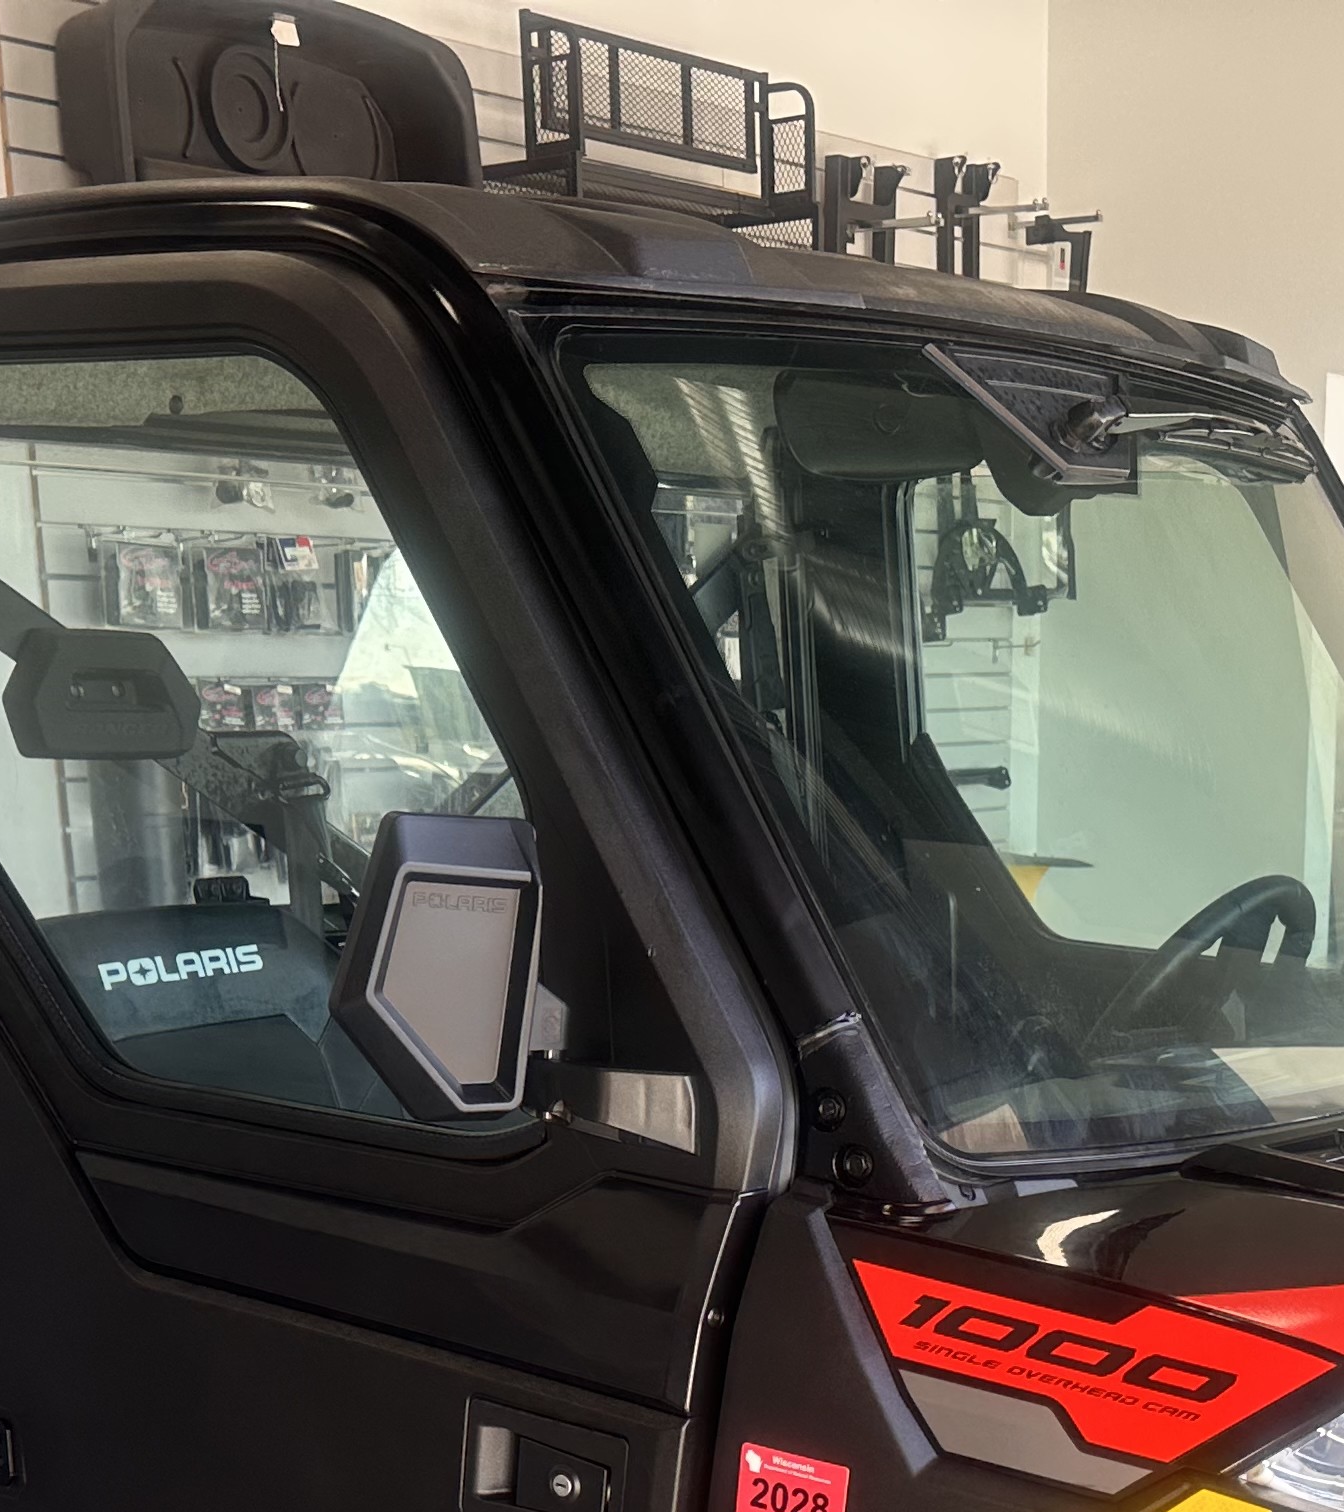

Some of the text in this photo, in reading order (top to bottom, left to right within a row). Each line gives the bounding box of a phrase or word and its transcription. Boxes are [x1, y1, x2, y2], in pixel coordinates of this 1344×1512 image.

[412, 891, 509, 914] POLARIS
[97, 943, 264, 991] POLARIS
[899, 1294, 1239, 1403] 1000
[913, 1340, 1202, 1423] SINGLE OVERHEAD CAM
[772, 1456, 815, 1474] Wisconsin
